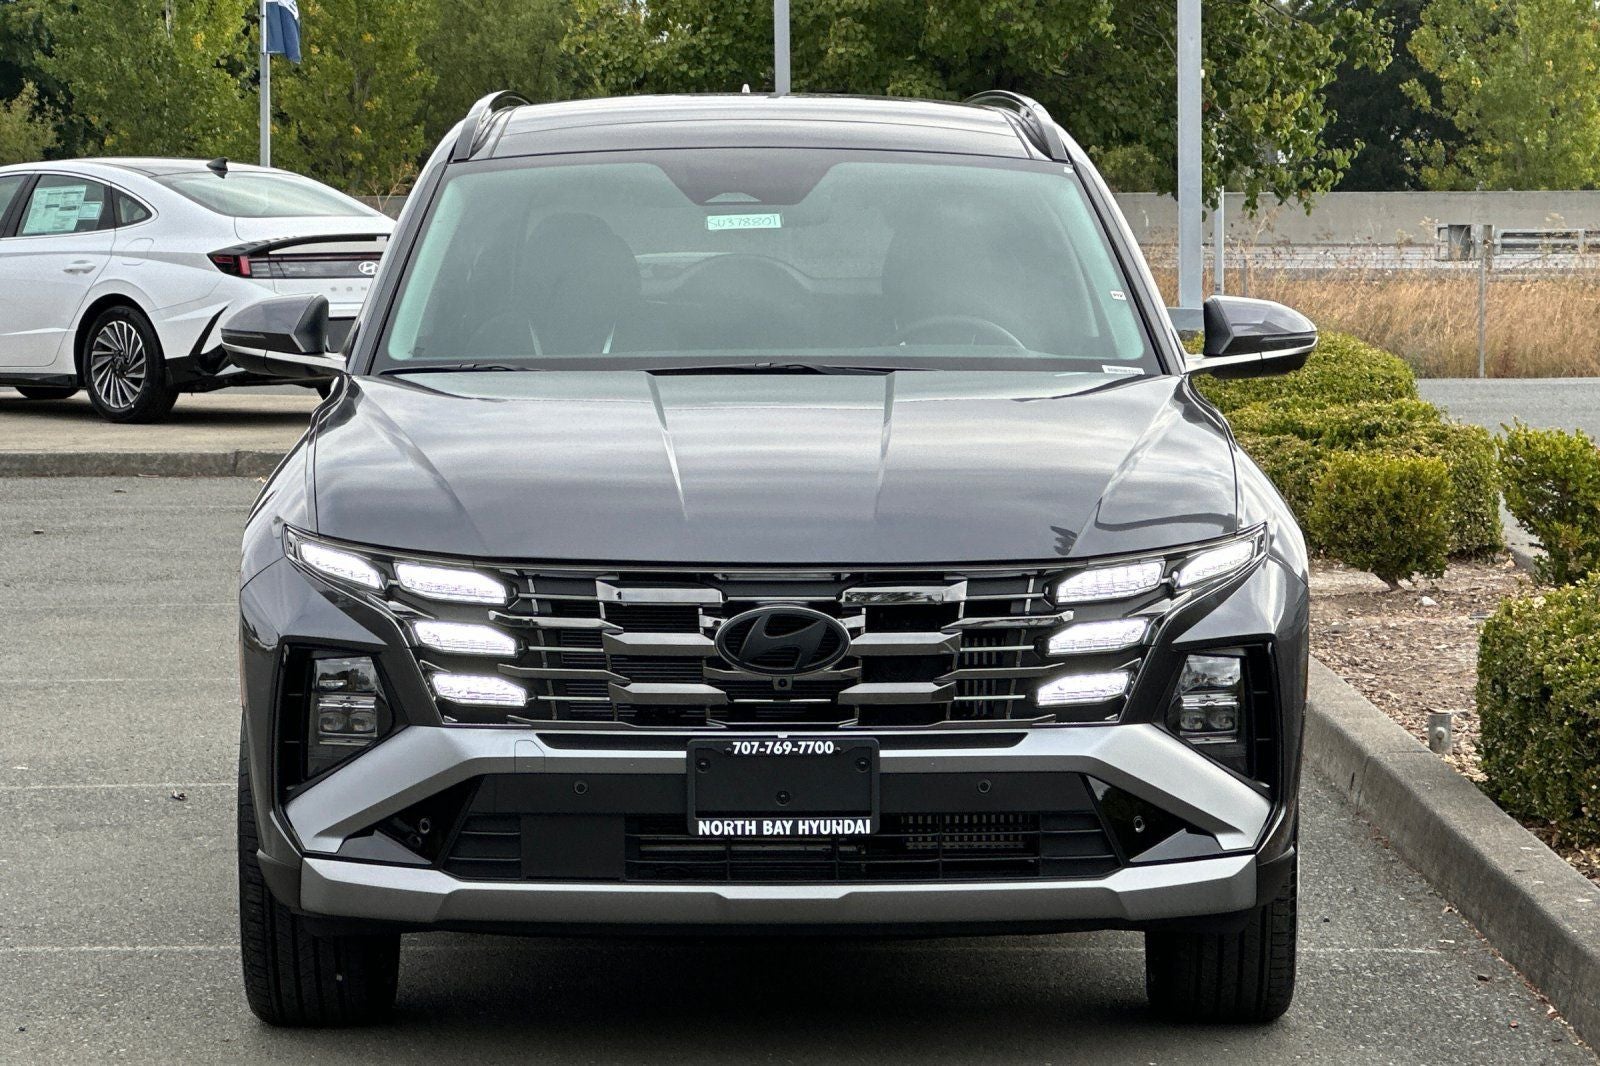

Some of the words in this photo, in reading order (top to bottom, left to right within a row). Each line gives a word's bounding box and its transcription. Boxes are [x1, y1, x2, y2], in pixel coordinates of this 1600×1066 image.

[732, 741, 834, 755] 707-769-7700
[698, 820, 757, 836] NORTH
[763, 820, 793, 836] BAY
[798, 819, 871, 835] HYUNDAI
